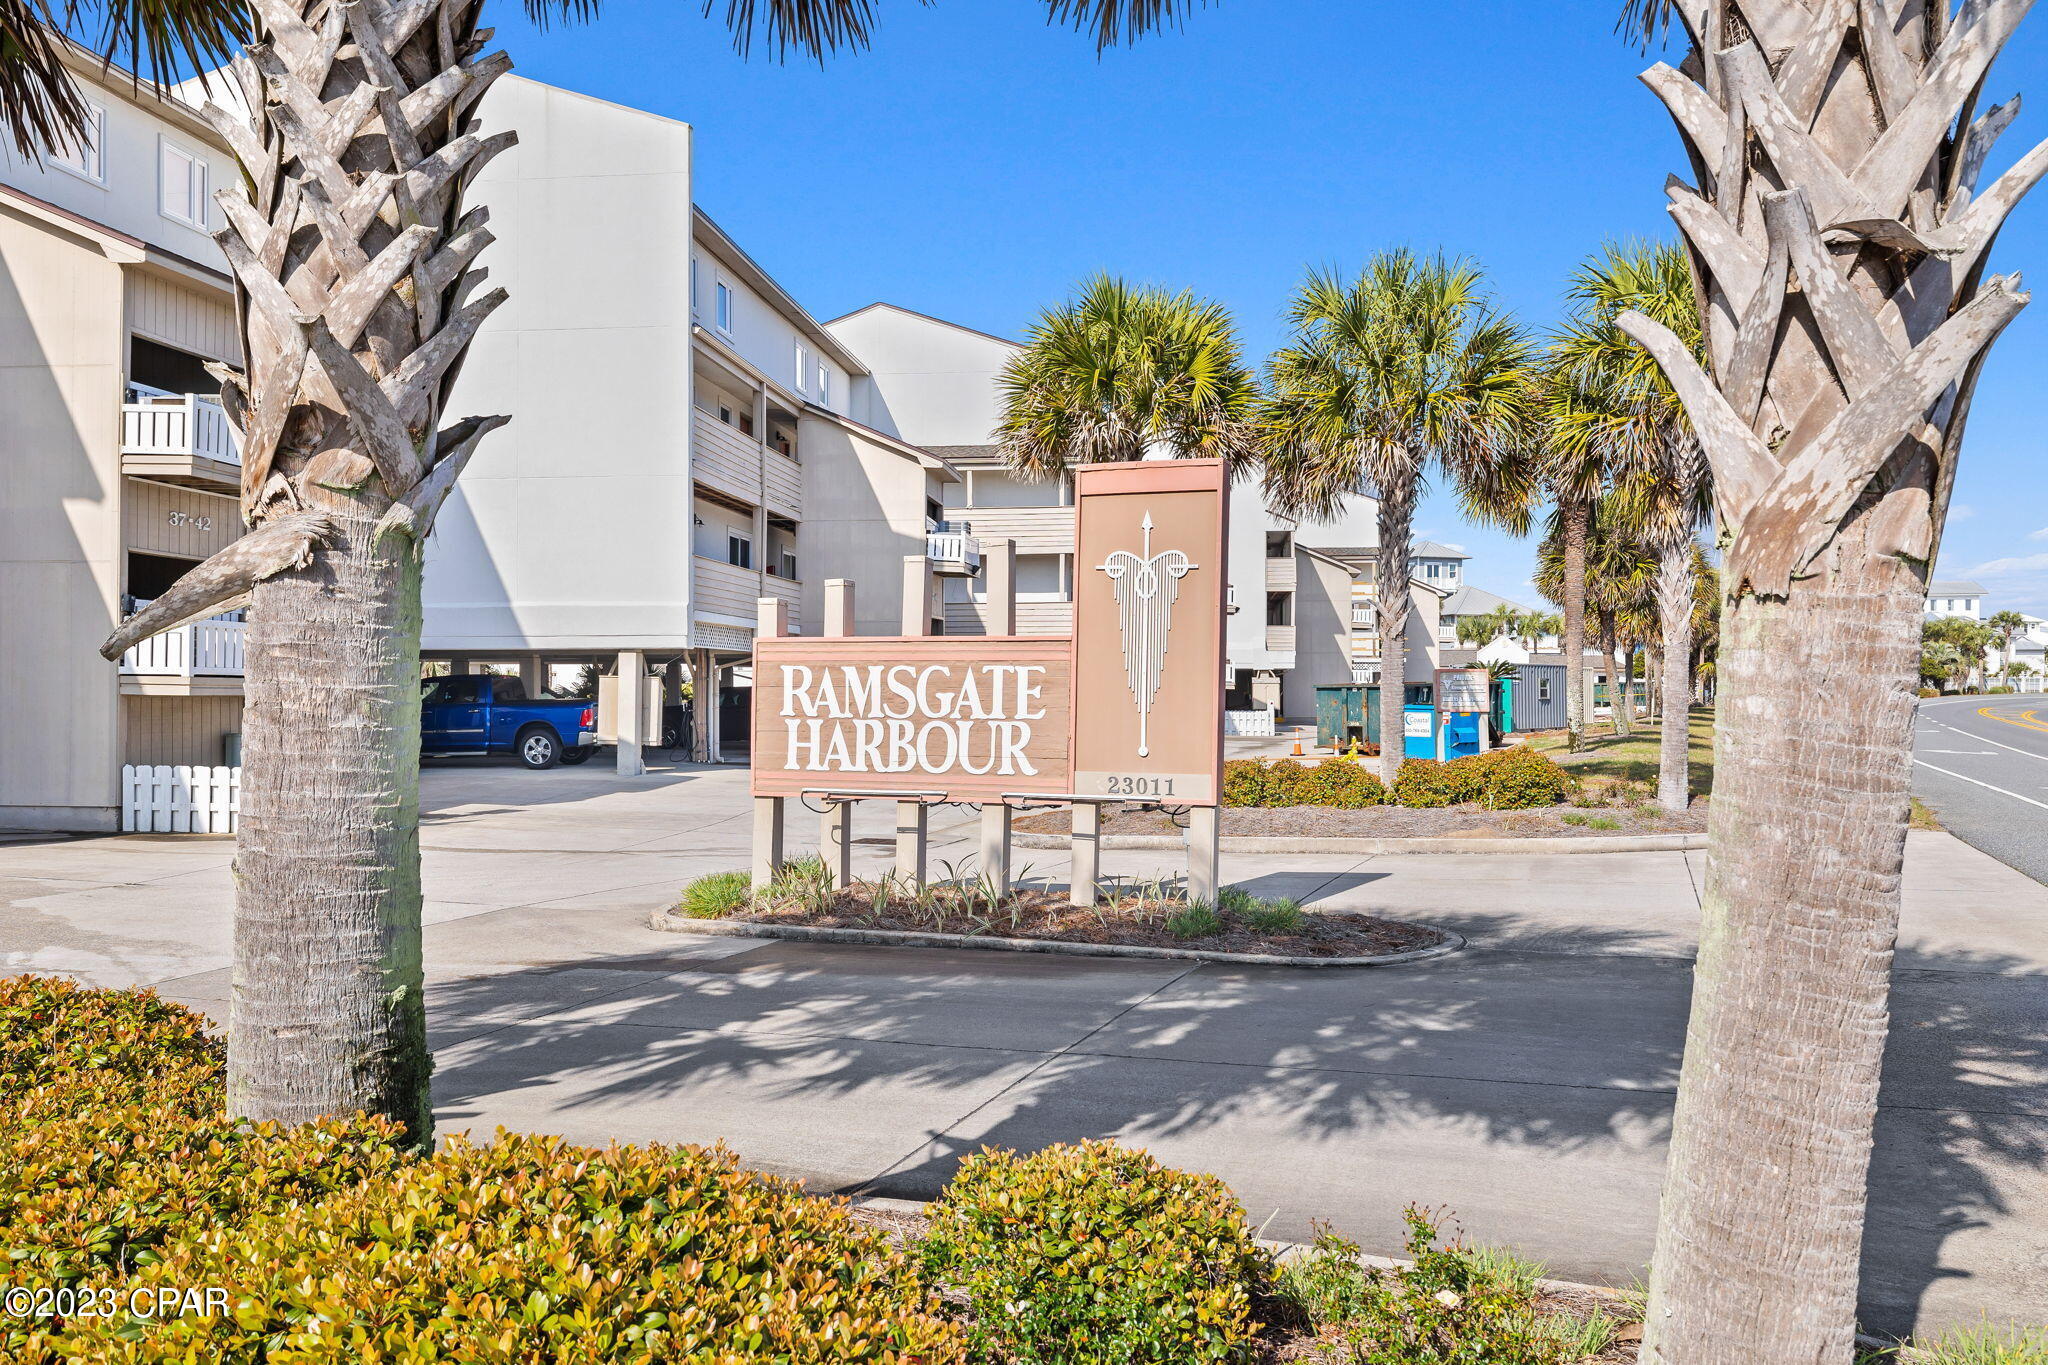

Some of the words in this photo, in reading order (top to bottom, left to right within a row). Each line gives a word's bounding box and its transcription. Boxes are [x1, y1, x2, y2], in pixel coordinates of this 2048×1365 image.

[779, 664, 1047, 720] RAMSGATE
[783, 718, 1040, 776] HARBOUR
[1107, 776, 1175, 796] 23011
